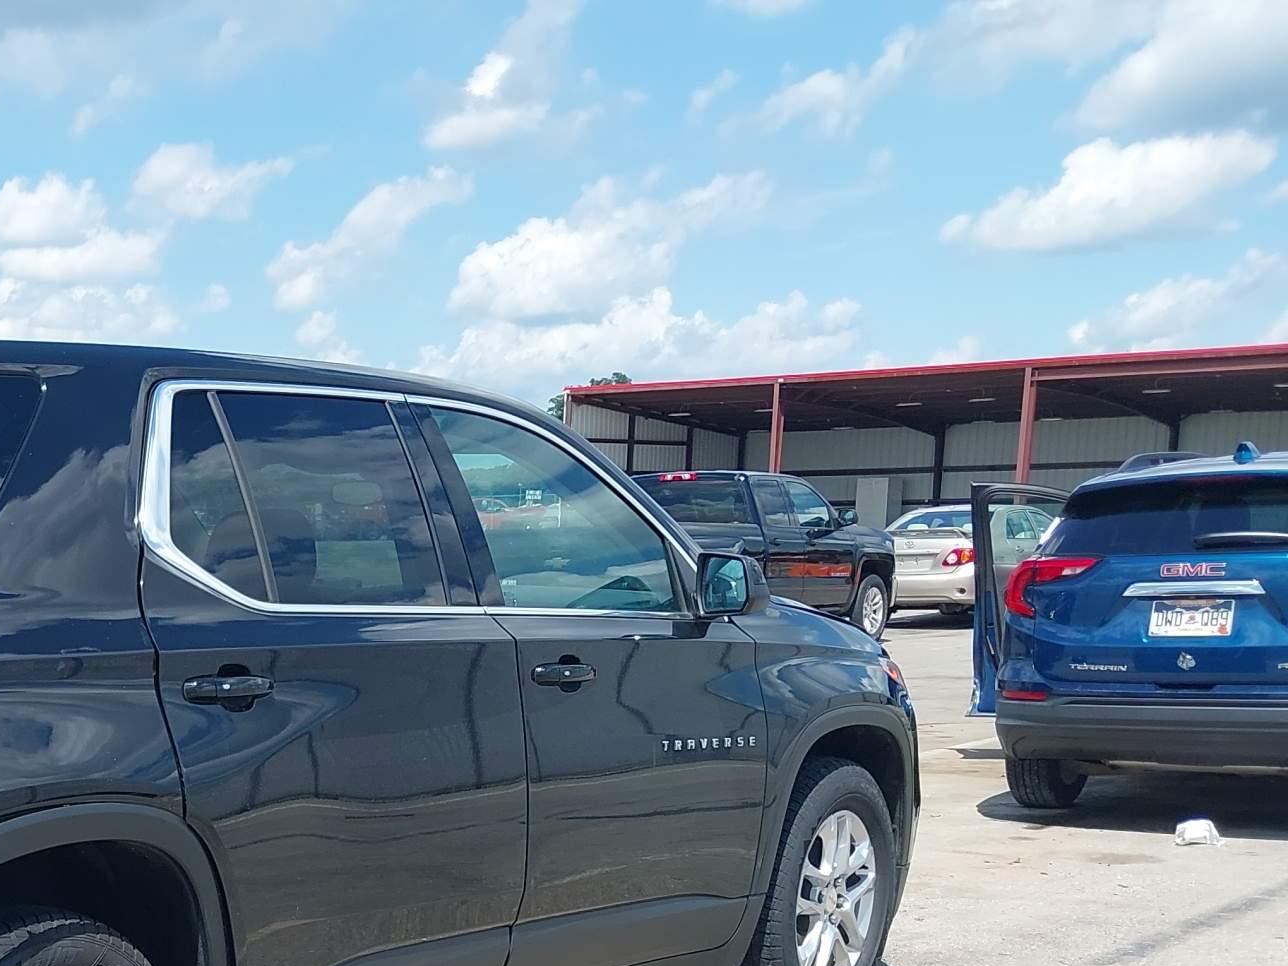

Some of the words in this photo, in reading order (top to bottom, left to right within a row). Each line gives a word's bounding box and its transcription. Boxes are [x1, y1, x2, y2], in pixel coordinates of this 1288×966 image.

[1159, 562, 1227, 577] GMC
[1068, 662, 1128, 672] TERRAIN
[661, 736, 757, 752] TRAVERSE
